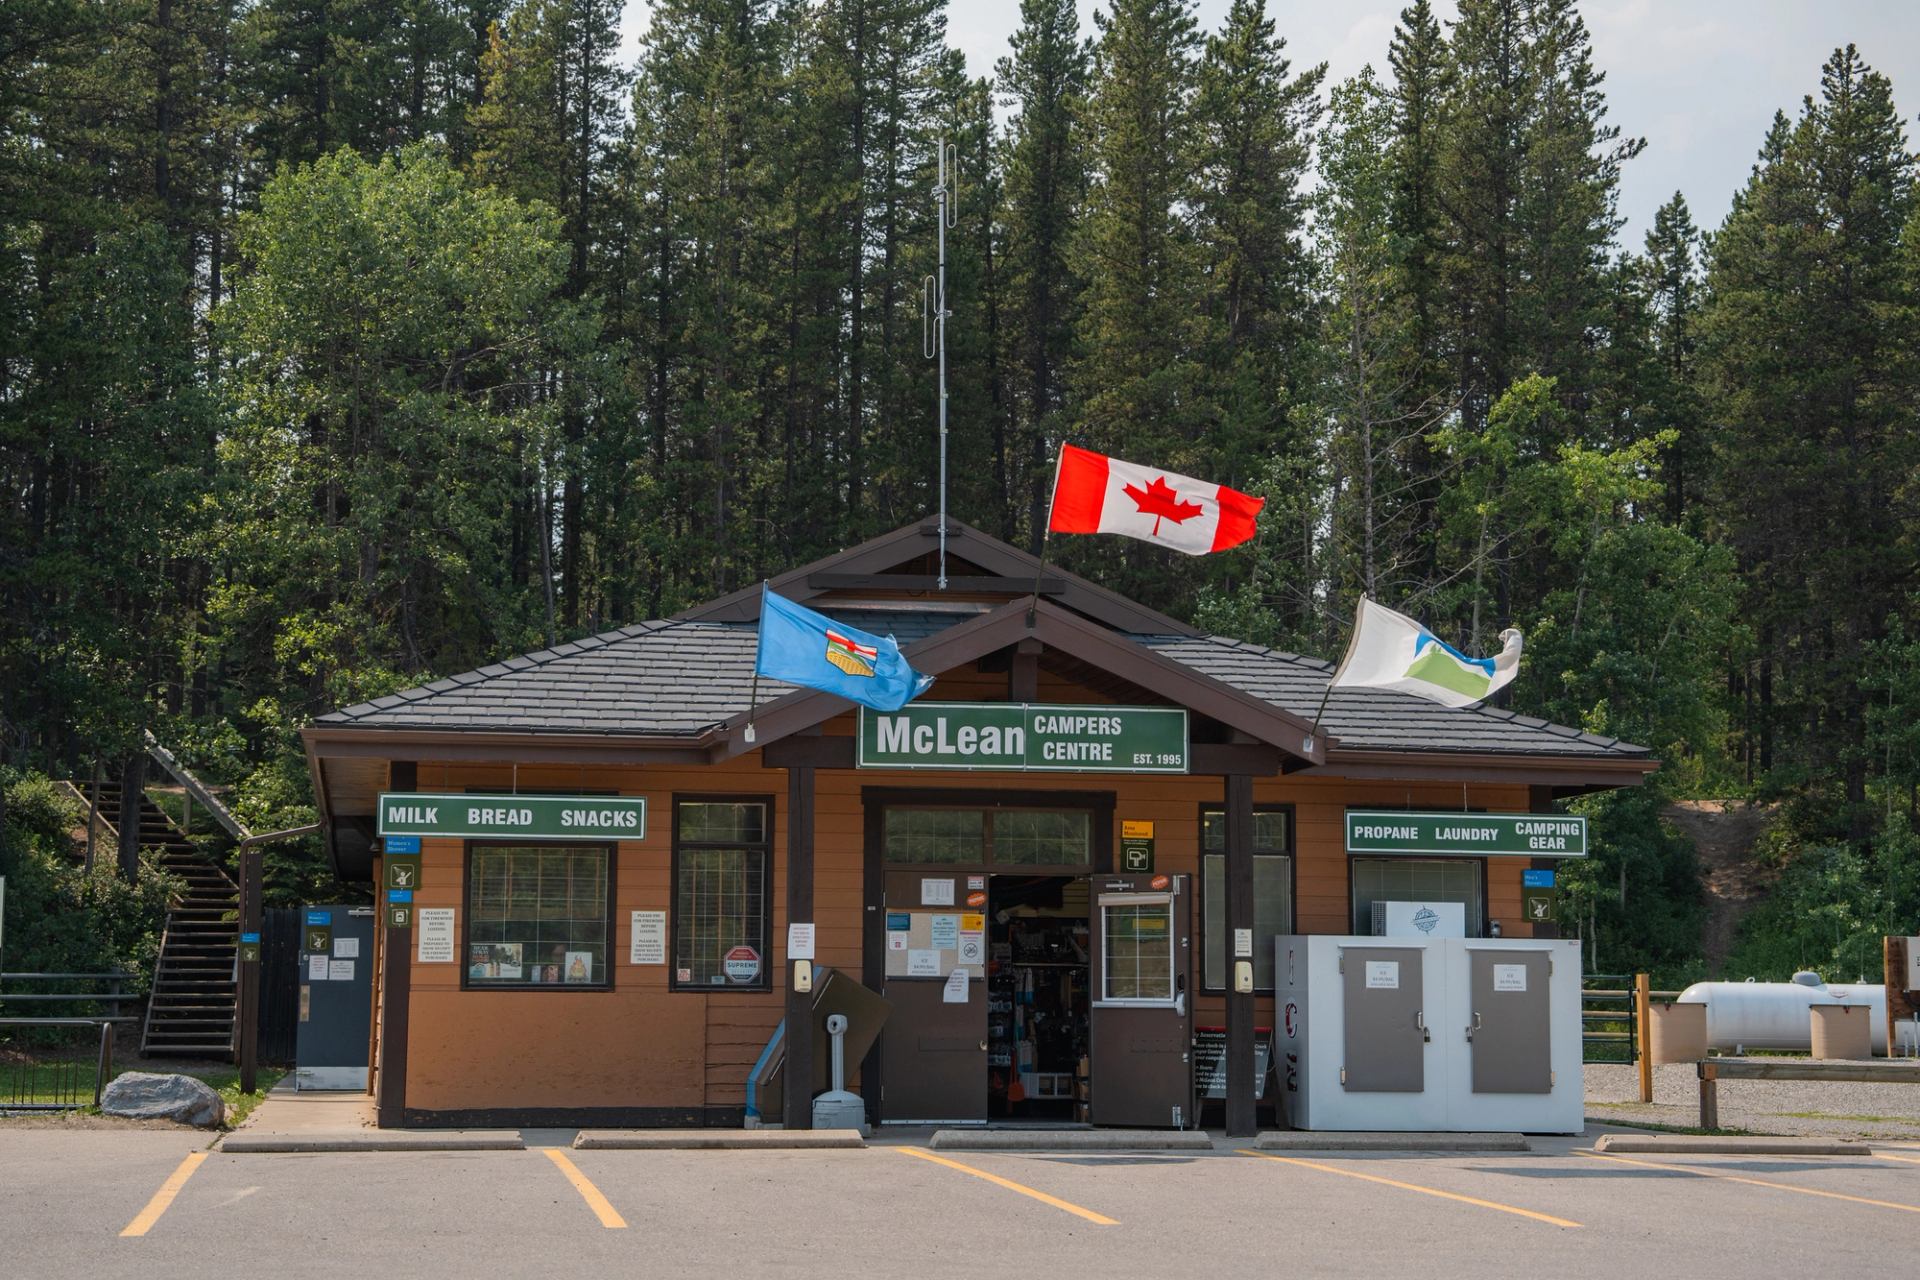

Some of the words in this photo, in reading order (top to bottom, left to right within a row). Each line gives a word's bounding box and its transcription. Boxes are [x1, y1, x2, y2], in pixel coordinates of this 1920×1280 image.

[1034, 715, 1122, 736] CAMPERS
[877, 716, 1025, 755] McLean
[1043, 741, 1113, 761] CENTRE
[1133, 753, 1153, 765] EST.
[1156, 754, 1182, 766] 1995
[388, 806, 438, 824] MILK
[467, 808, 533, 826] BREAD
[561, 809, 638, 828] SNACKS
[1354, 826, 1419, 840] PROPANE
[1435, 827, 1499, 841] LAUNDRY
[1515, 822, 1580, 837] CAMPING
[1529, 836, 1566, 850] GEAR
